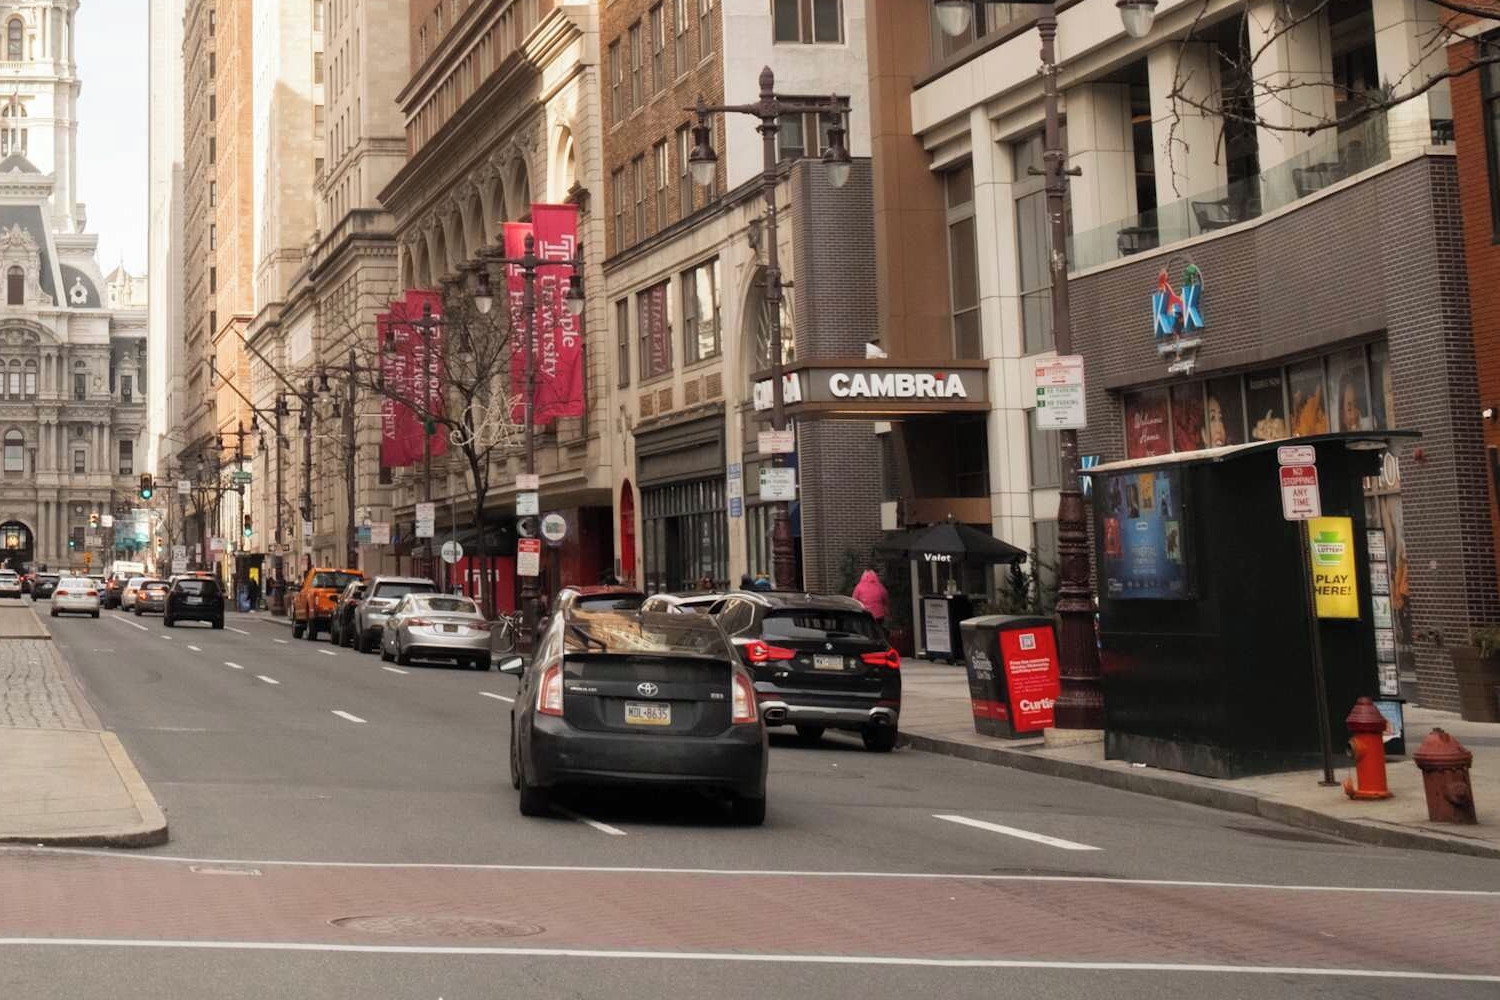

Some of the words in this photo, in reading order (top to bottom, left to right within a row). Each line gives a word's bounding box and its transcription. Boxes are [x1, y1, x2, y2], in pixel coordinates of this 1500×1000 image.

[540, 273, 560, 378] University
[1292, 466, 1304, 475] NO
[1282, 475, 1317, 487] STOPPING
[1292, 488, 1309, 498] ANY
[1292, 498, 1309, 507] TIME
[924, 553, 952, 562] Valet
[1315, 574, 1349, 584] PLAY
[1314, 585, 1352, 596] HERE!
